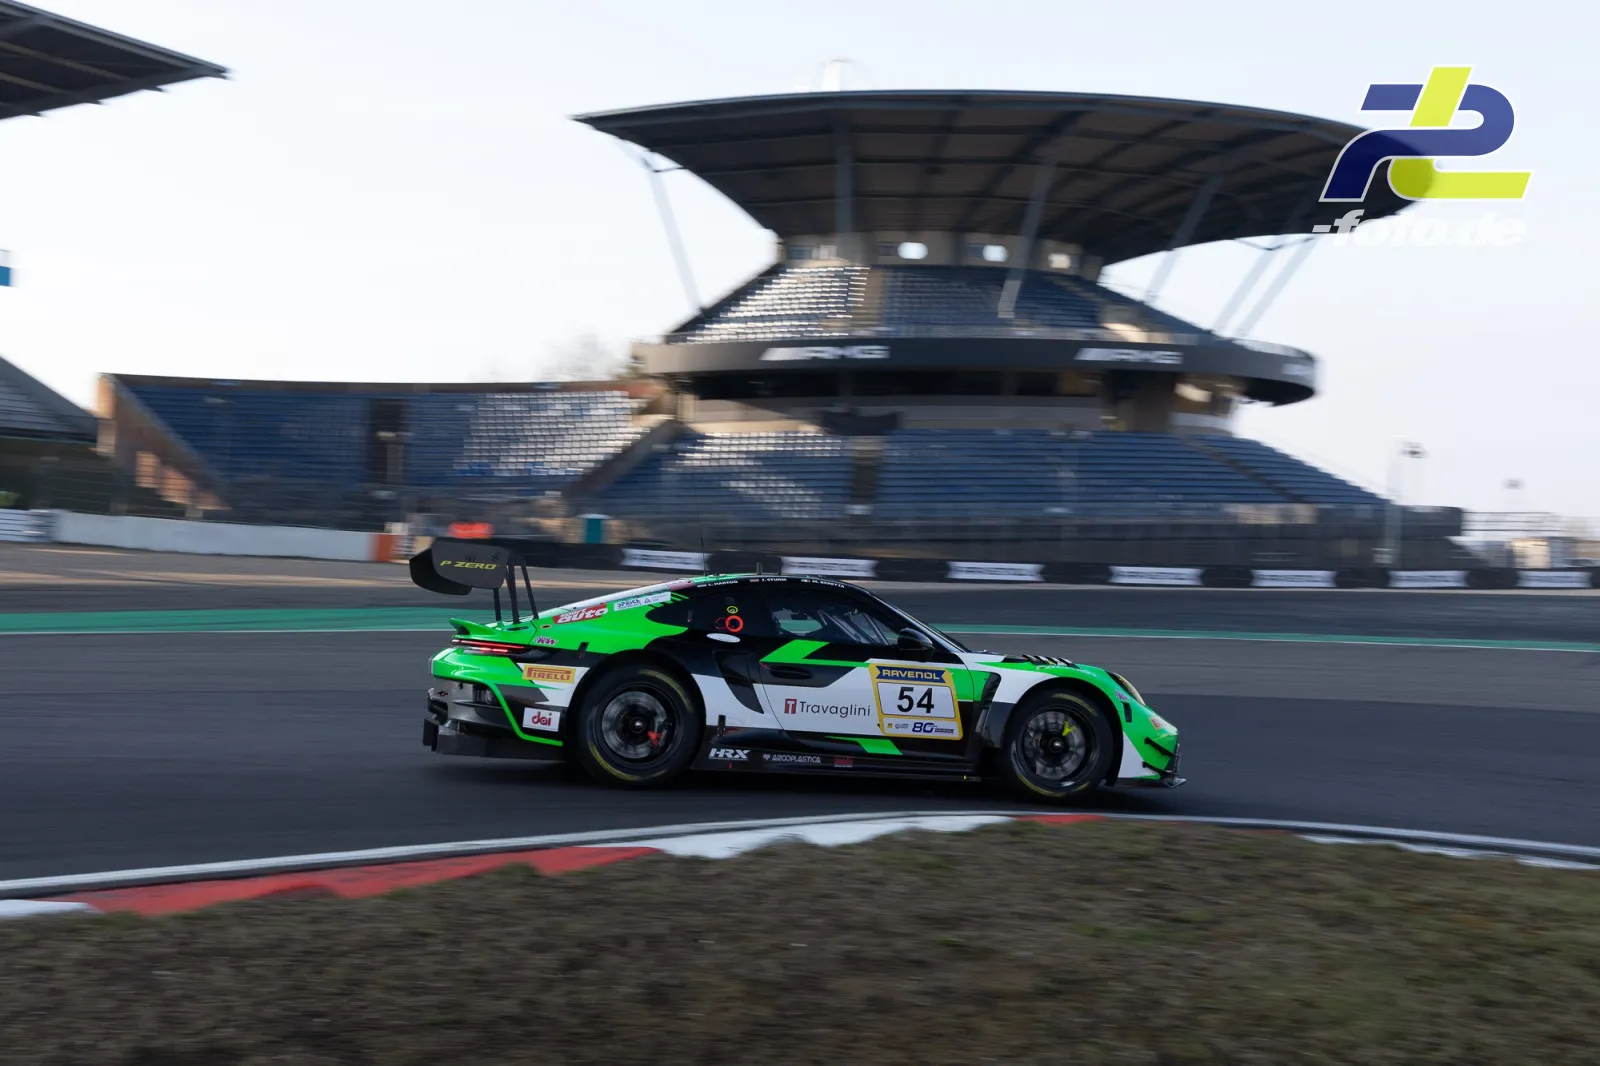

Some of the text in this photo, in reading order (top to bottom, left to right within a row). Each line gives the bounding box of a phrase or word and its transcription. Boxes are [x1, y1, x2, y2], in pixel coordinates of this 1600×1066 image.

[454, 561, 497, 570] ZERO
[557, 608, 609, 624] auto
[526, 667, 572, 681] PIRELLI
[882, 669, 940, 680] RAVENOL
[897, 686, 935, 714] 54
[800, 701, 871, 718] Travaglini
[531, 711, 552, 726] dai
[912, 722, 935, 733] 80
[709, 747, 751, 759] HRX
[772, 754, 821, 764] ARCOPLASTICA
